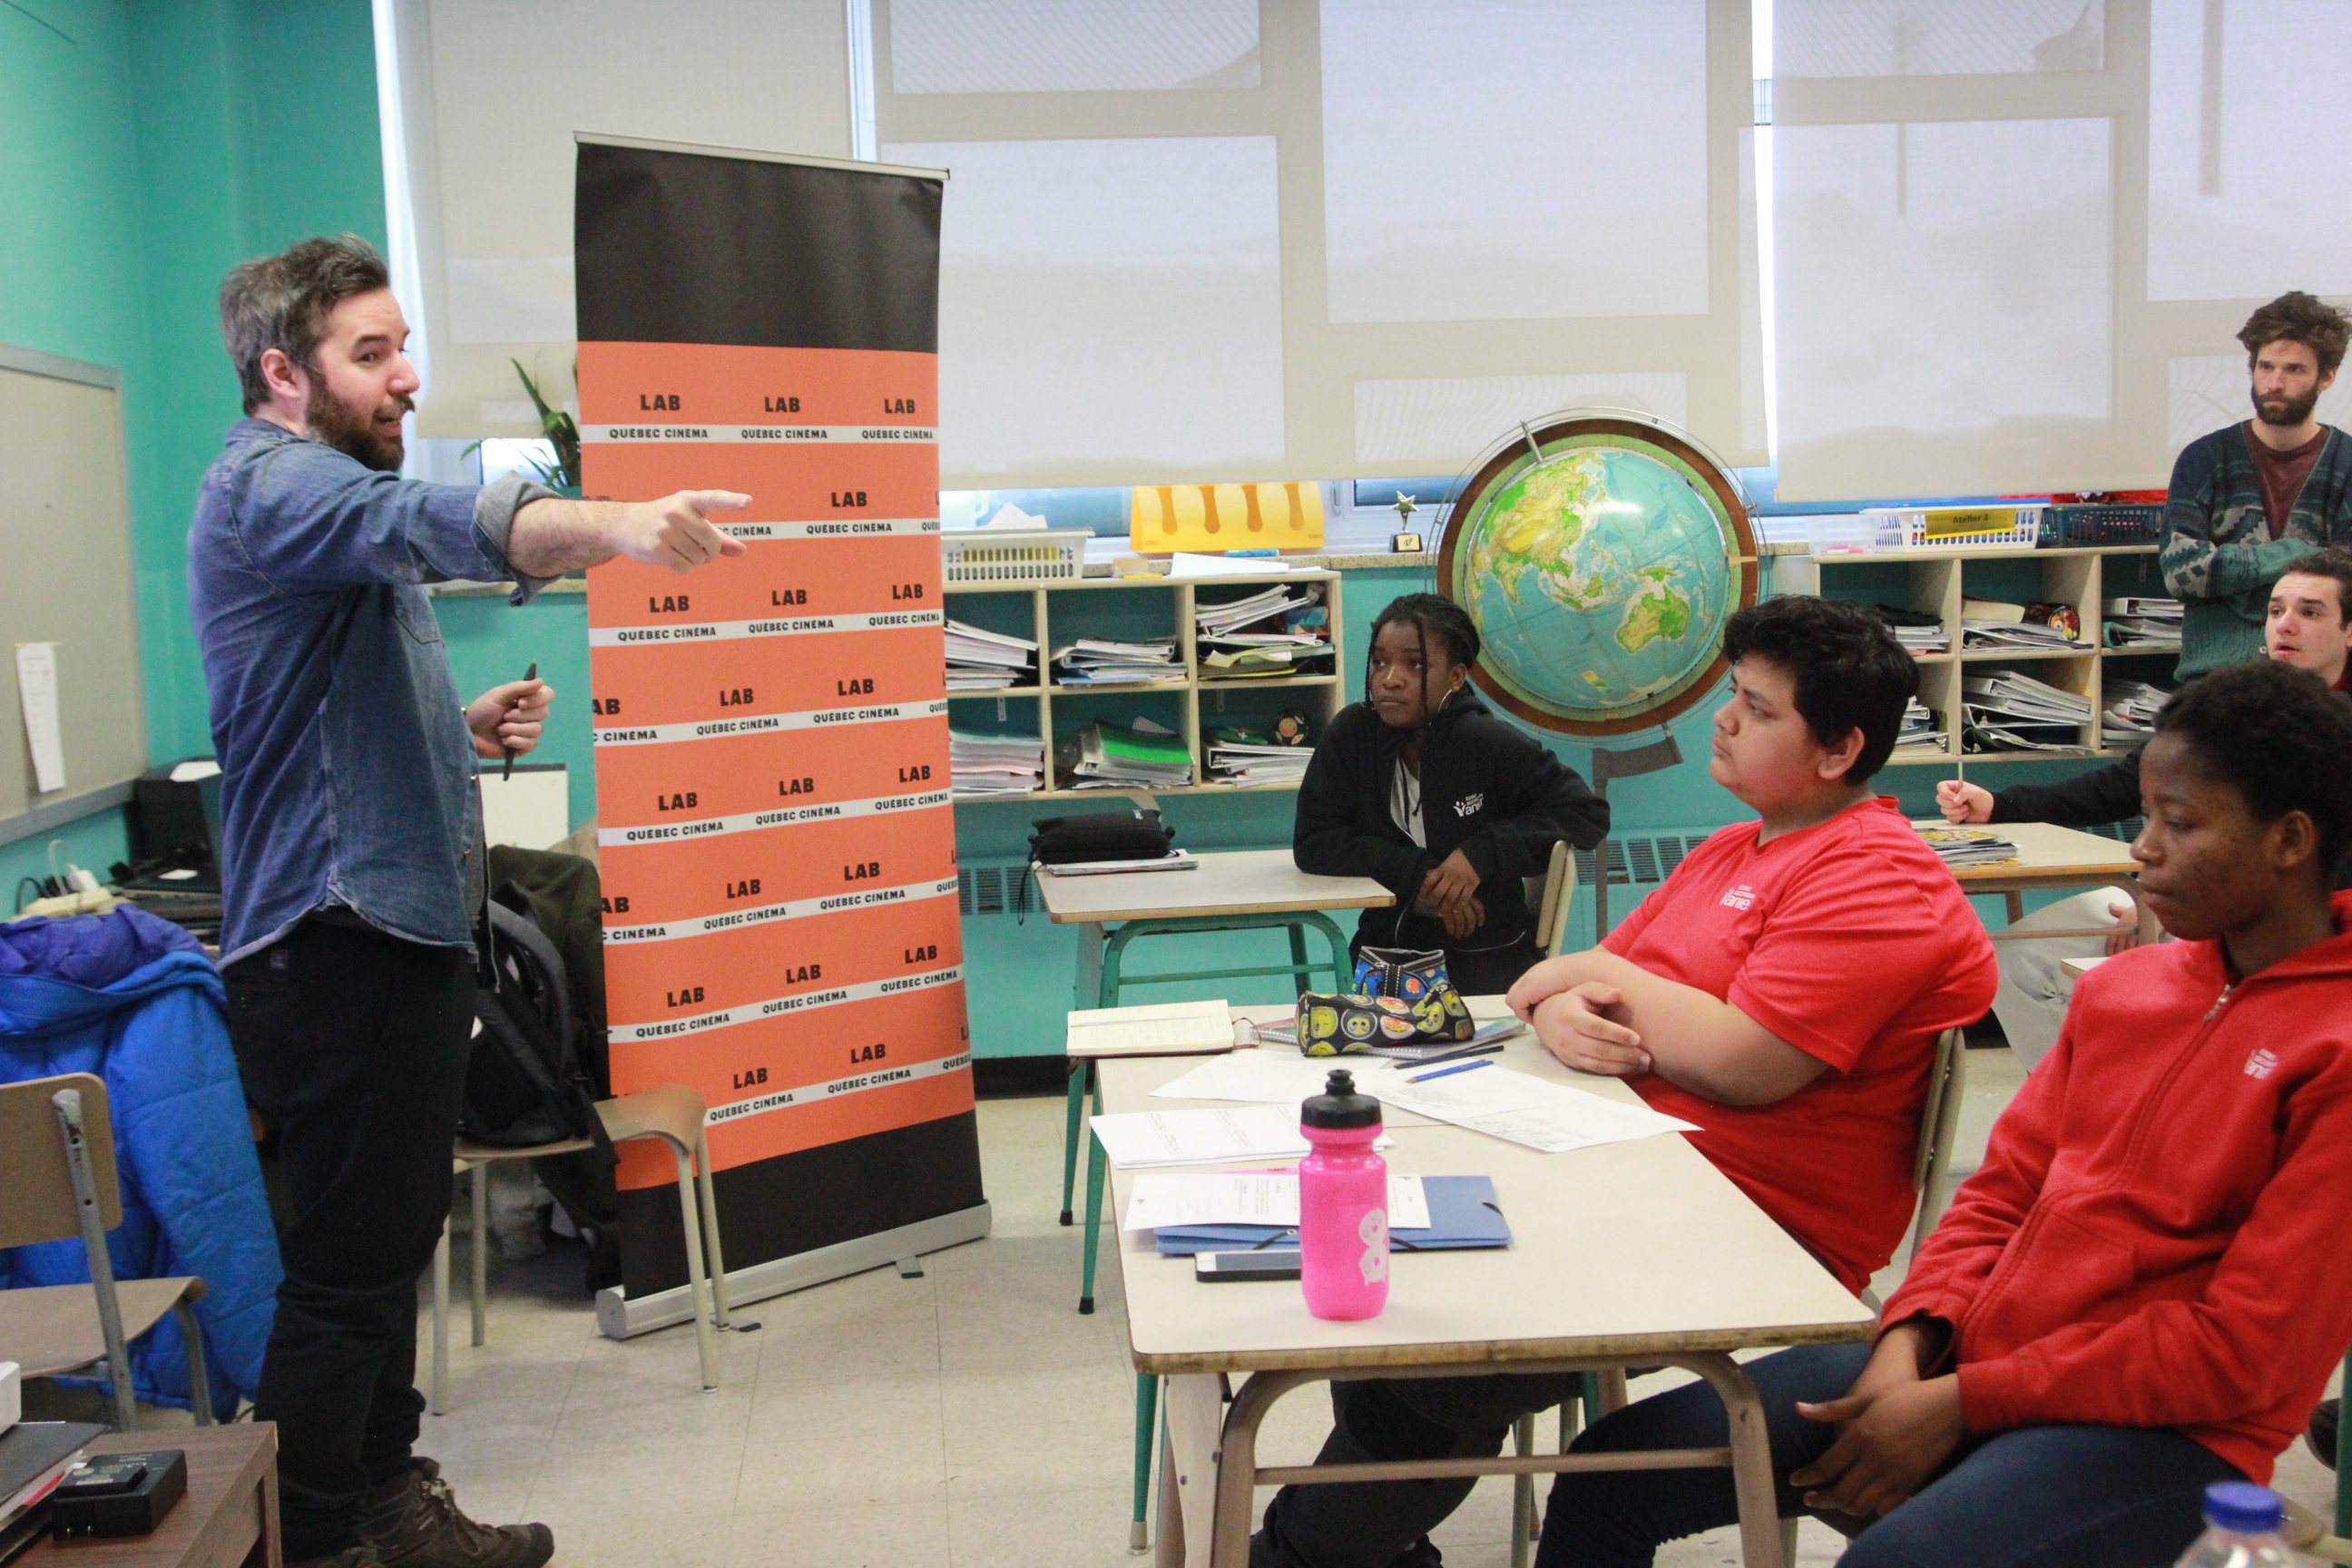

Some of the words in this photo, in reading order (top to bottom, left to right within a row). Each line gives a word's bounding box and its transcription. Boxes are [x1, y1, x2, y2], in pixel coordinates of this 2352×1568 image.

[641, 394, 681, 411] LAB
[764, 397, 800, 413] LAB
[885, 398, 916, 414] LAB
[610, 428, 660, 438] QUÉBEC
[665, 428, 708, 437] CINÉMA
[741, 429, 781, 439] QUÉBEC
[785, 429, 827, 438] CINÉMA
[862, 430, 899, 439] QUÉBEC
[903, 429, 933, 438] CINÉMA
[831, 491, 867, 507] LAB
[1953, 514, 1981, 524] Atelier
[807, 524, 848, 534] QUÉBEC
[852, 523, 892, 532] CINÉMA
[772, 589, 808, 606] LAB
[892, 583, 923, 600] LAB
[650, 595, 690, 613] LAB
[749, 622, 789, 633] QUÉBEC
[792, 620, 834, 630] CINÉMA
[869, 615, 907, 626] QUÉBEC
[911, 613, 939, 622] CINÉMA
[618, 630, 669, 642] QUÉBEC
[673, 627, 716, 638] CINÉMA
[838, 678, 874, 696] LAB
[593, 698, 621, 715] AB
[720, 688, 754, 707] LAB
[814, 711, 855, 723] QUÉBEC
[858, 708, 899, 719] CINÉMA
[697, 723, 736, 735] QUÉBEC
[740, 719, 779, 730] CINÉMA
[899, 765, 930, 783] LAB
[779, 777, 814, 796] LAB
[658, 792, 698, 811] LAB
[875, 798, 915, 810] QUÉBEC
[918, 793, 947, 805] CINÉMA
[756, 812, 795, 825] QUÉBEC
[799, 807, 840, 818] CINÉMA
[627, 828, 678, 840] QUÉBEC
[682, 822, 723, 835] CINÉMA
[844, 862, 880, 881] LAB
[727, 878, 760, 899] LAB
[601, 897, 630, 913] AB
[820, 896, 861, 909] QUÉBEC
[865, 890, 905, 903] CINÉMA
[704, 915, 742, 929] QUÉBEC
[747, 907, 786, 921] CINÉMA
[905, 945, 937, 965] LAB
[786, 964, 821, 985] LAB
[881, 978, 920, 992] QUÉBEC
[924, 970, 957, 985] CINÉMA
[667, 986, 705, 1008] LAB
[763, 999, 802, 1014] QUÉBEC
[807, 991, 847, 1004] CINÉMA
[636, 1023, 685, 1038] QUÉBEC
[690, 1014, 730, 1029] CINÉMA
[850, 1044, 887, 1064] LAB
[733, 1067, 768, 1090] LAB
[828, 1078, 867, 1093] QUÉBEC
[871, 1069, 911, 1084] CINÉMA
[710, 1103, 750, 1121] QUÉBEC
[753, 1093, 793, 1110] CINÉMA
